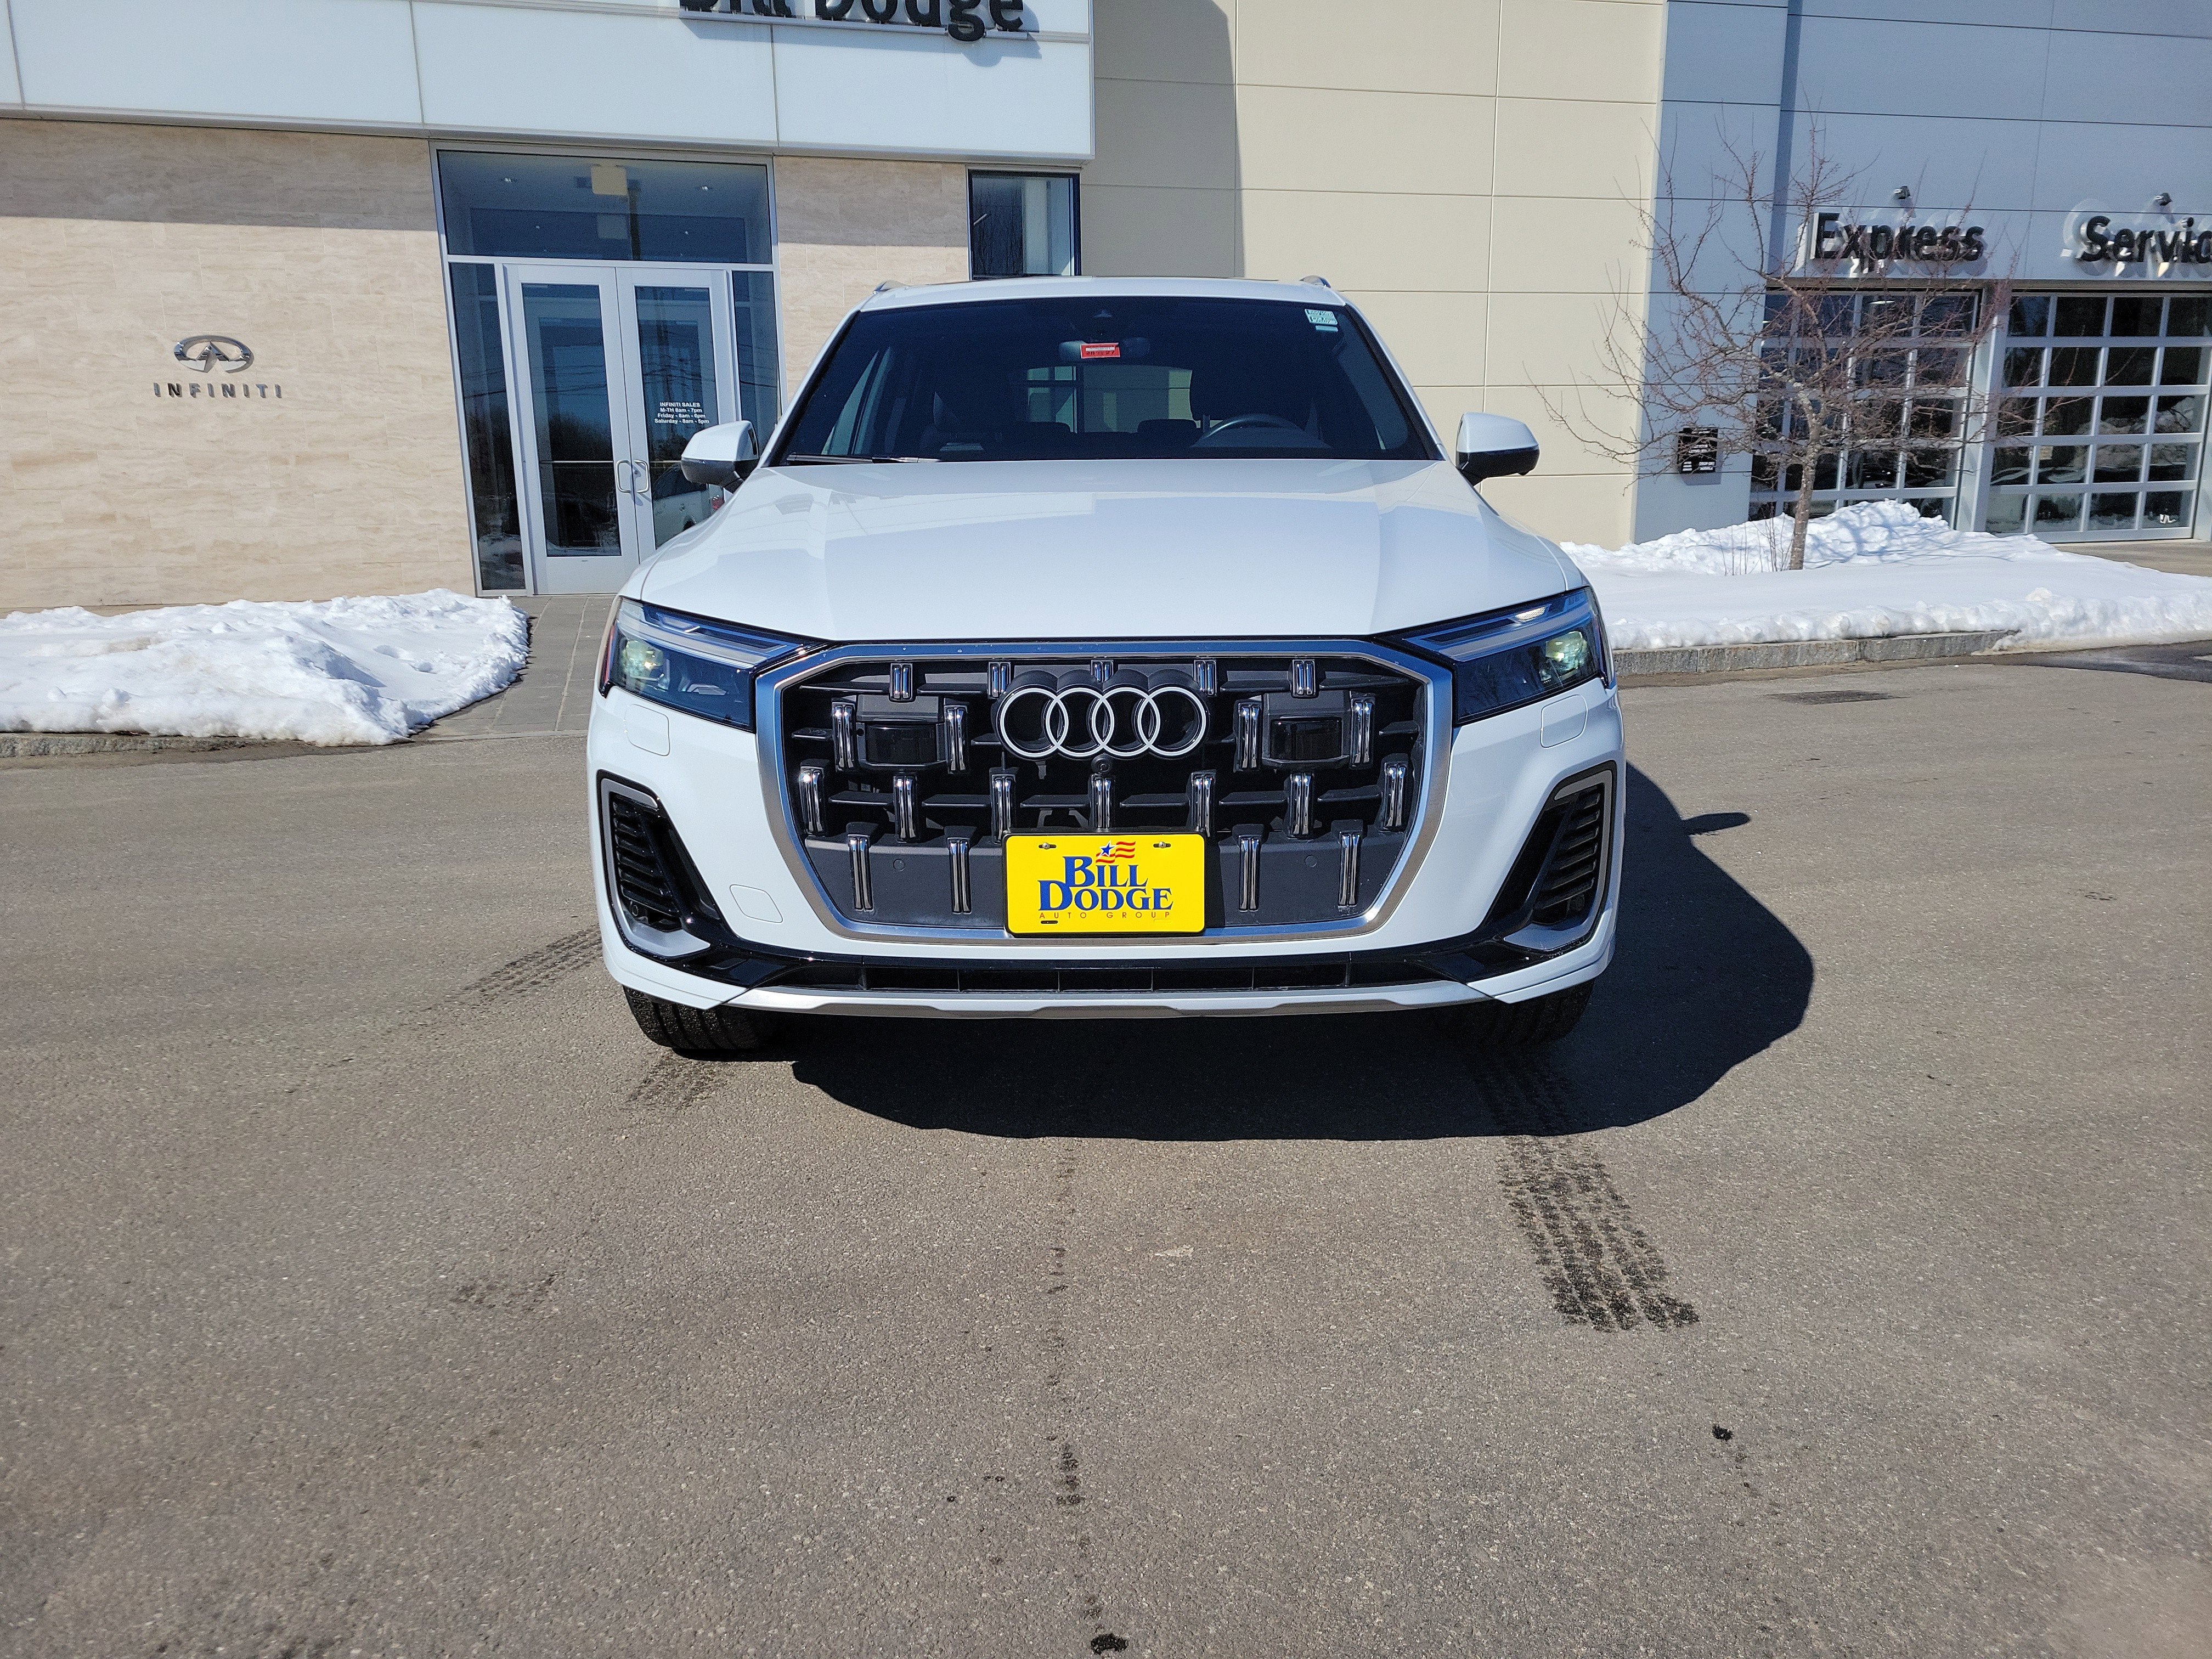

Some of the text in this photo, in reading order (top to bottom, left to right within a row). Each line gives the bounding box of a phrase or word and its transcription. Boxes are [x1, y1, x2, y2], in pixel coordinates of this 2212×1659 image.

[1815, 212, 1984, 273] Express
[153, 382, 282, 398] INFINITI
[1063, 856, 1148, 887] BILL
[1037, 879, 1173, 911] DODGE
